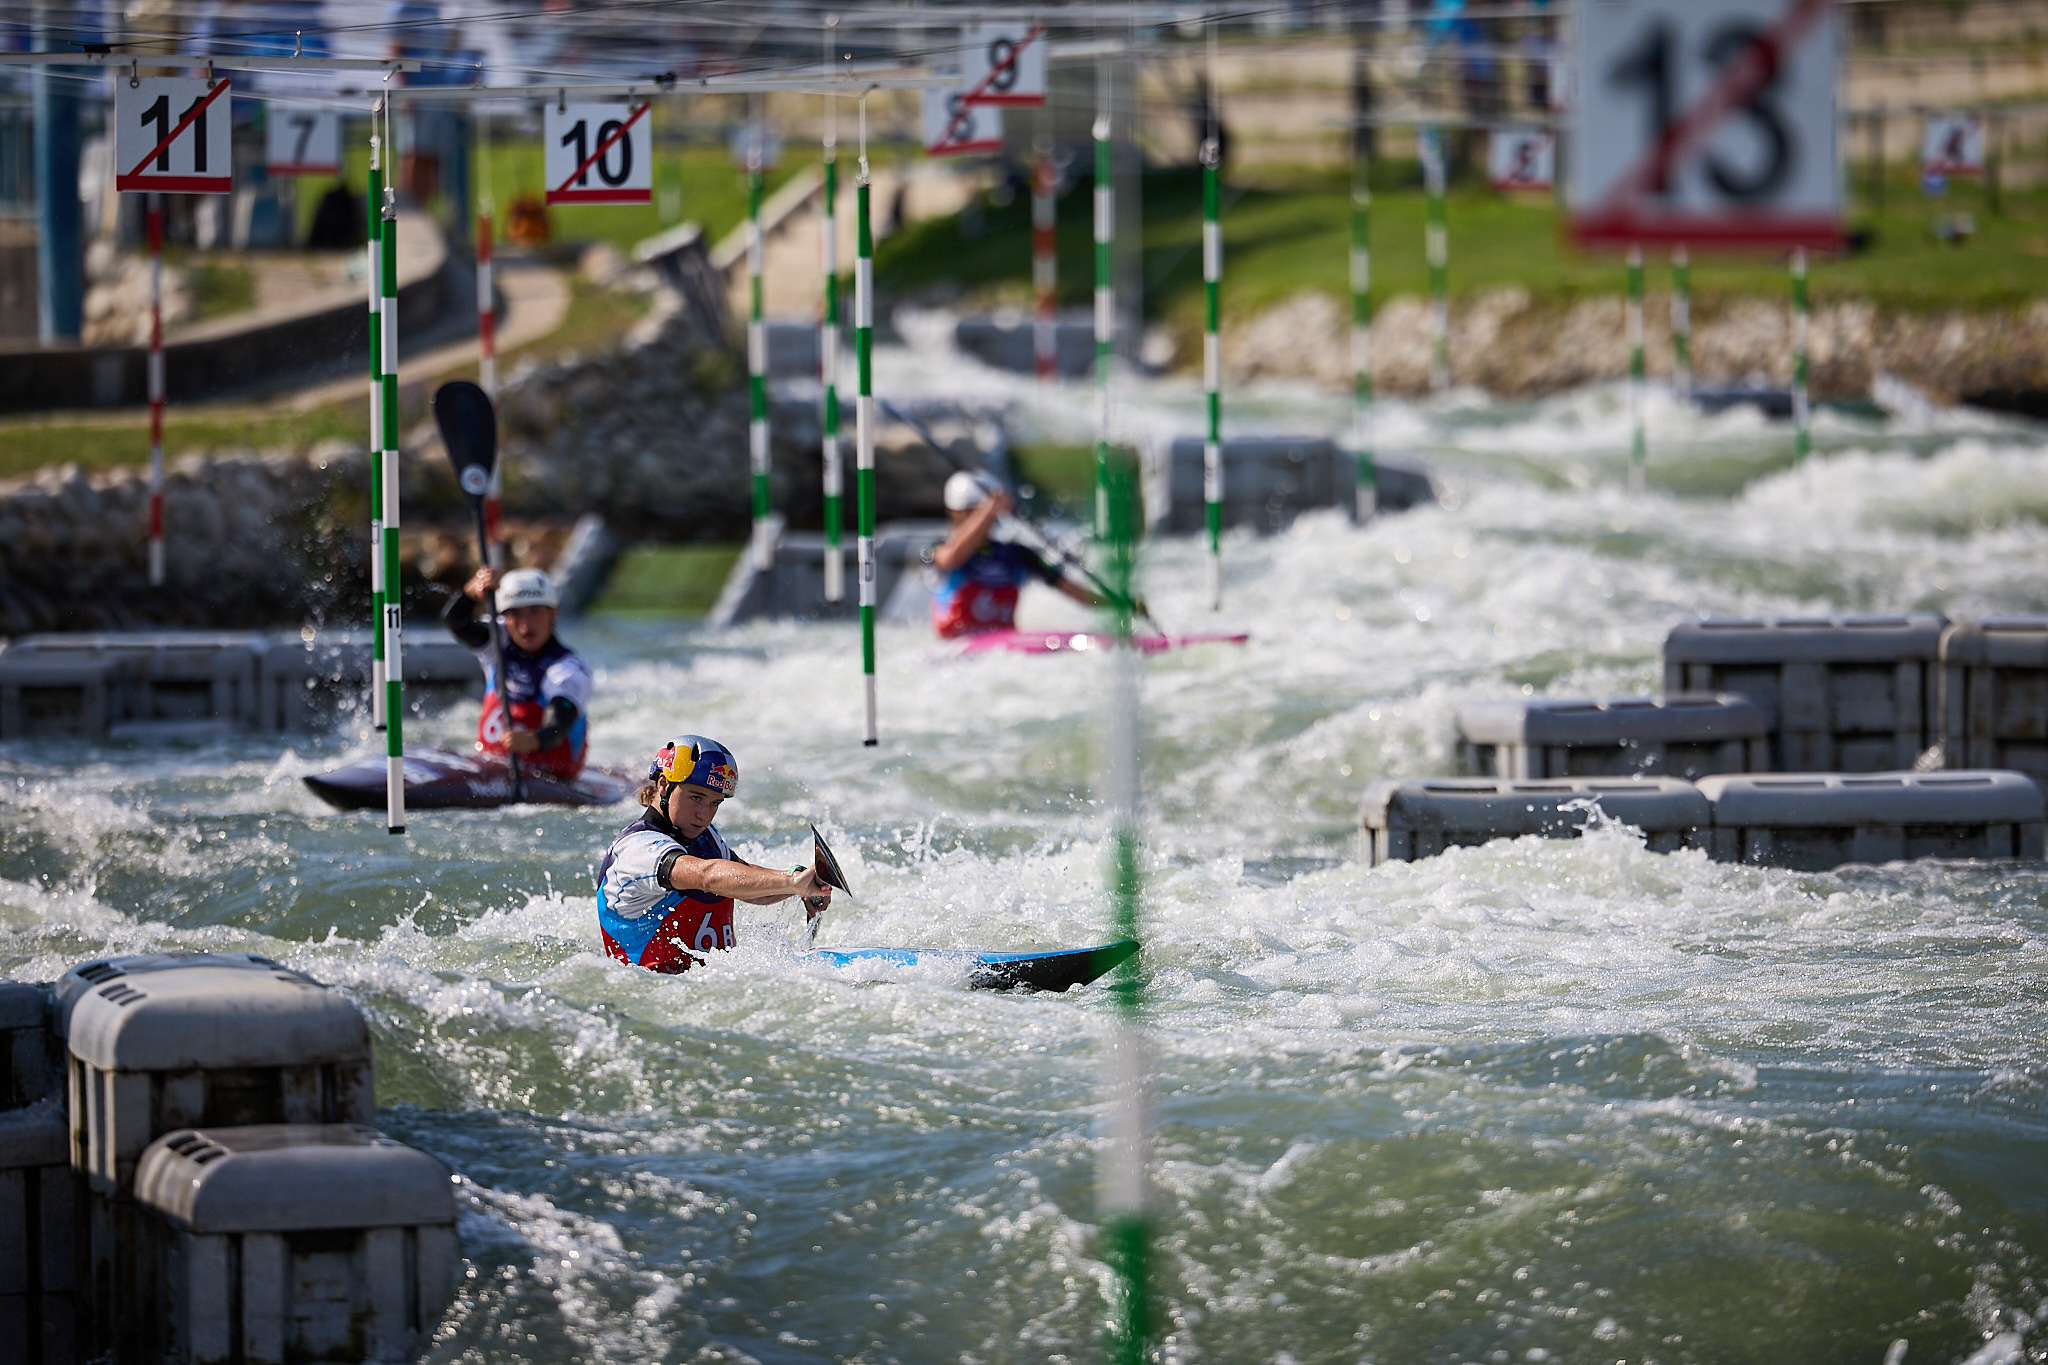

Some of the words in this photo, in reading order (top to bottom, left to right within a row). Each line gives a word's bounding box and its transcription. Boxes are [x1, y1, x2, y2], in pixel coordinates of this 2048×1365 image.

[988, 36, 1019, 92] 9
[141, 95, 207, 172] 11
[1606, 16, 1795, 202] 13
[289, 113, 314, 165] 7
[562, 119, 633, 188] 10
[386, 607, 400, 629] 11
[707, 774, 726, 789] Red
